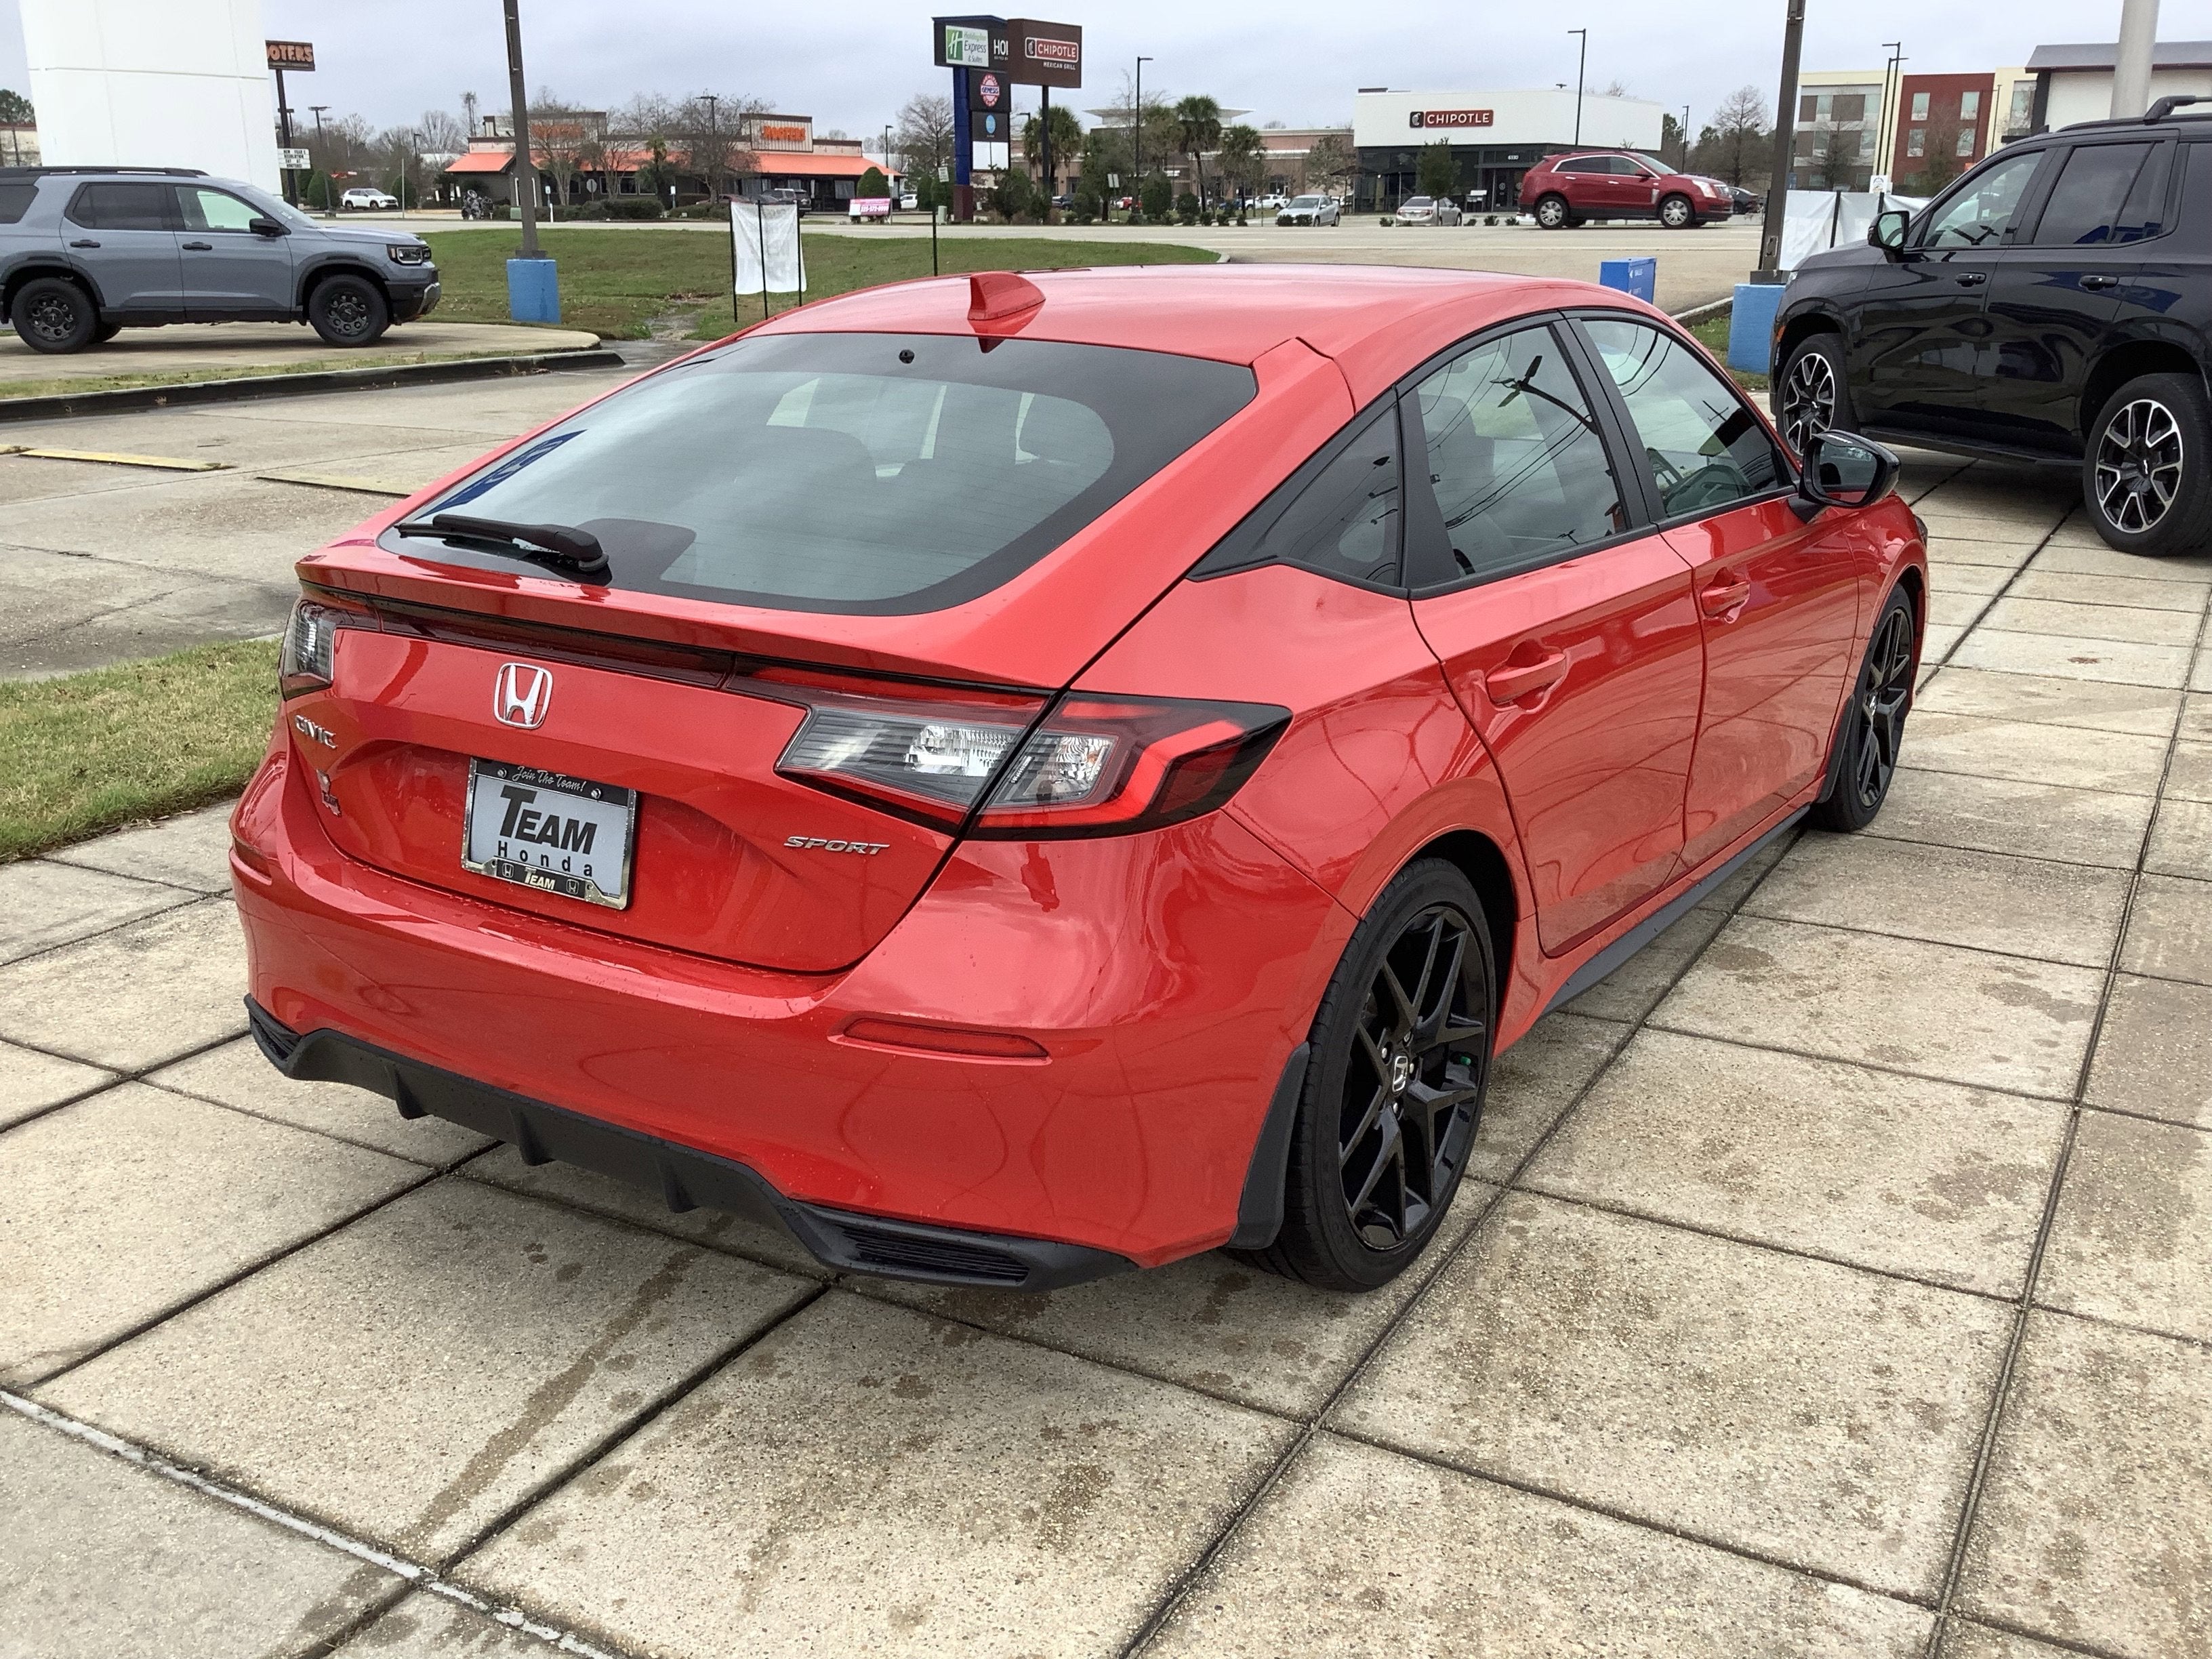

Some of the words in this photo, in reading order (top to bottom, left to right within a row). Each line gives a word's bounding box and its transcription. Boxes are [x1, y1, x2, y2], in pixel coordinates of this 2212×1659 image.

[266, 44, 313, 62] OTERS
[964, 40, 987, 53] Express
[1038, 43, 1076, 58] CHIPOTLE
[981, 86, 998, 94] GENESIS
[1427, 112, 1490, 124] CHIPOTLE
[295, 714, 337, 749] CIVIC
[512, 766, 536, 781] Join
[537, 770, 554, 784] The
[556, 774, 587, 792] Team!
[499, 785, 598, 855] TEAM
[783, 836, 890, 855] SPORT
[497, 840, 593, 877] Honda
[524, 867, 556, 890] TEAM
